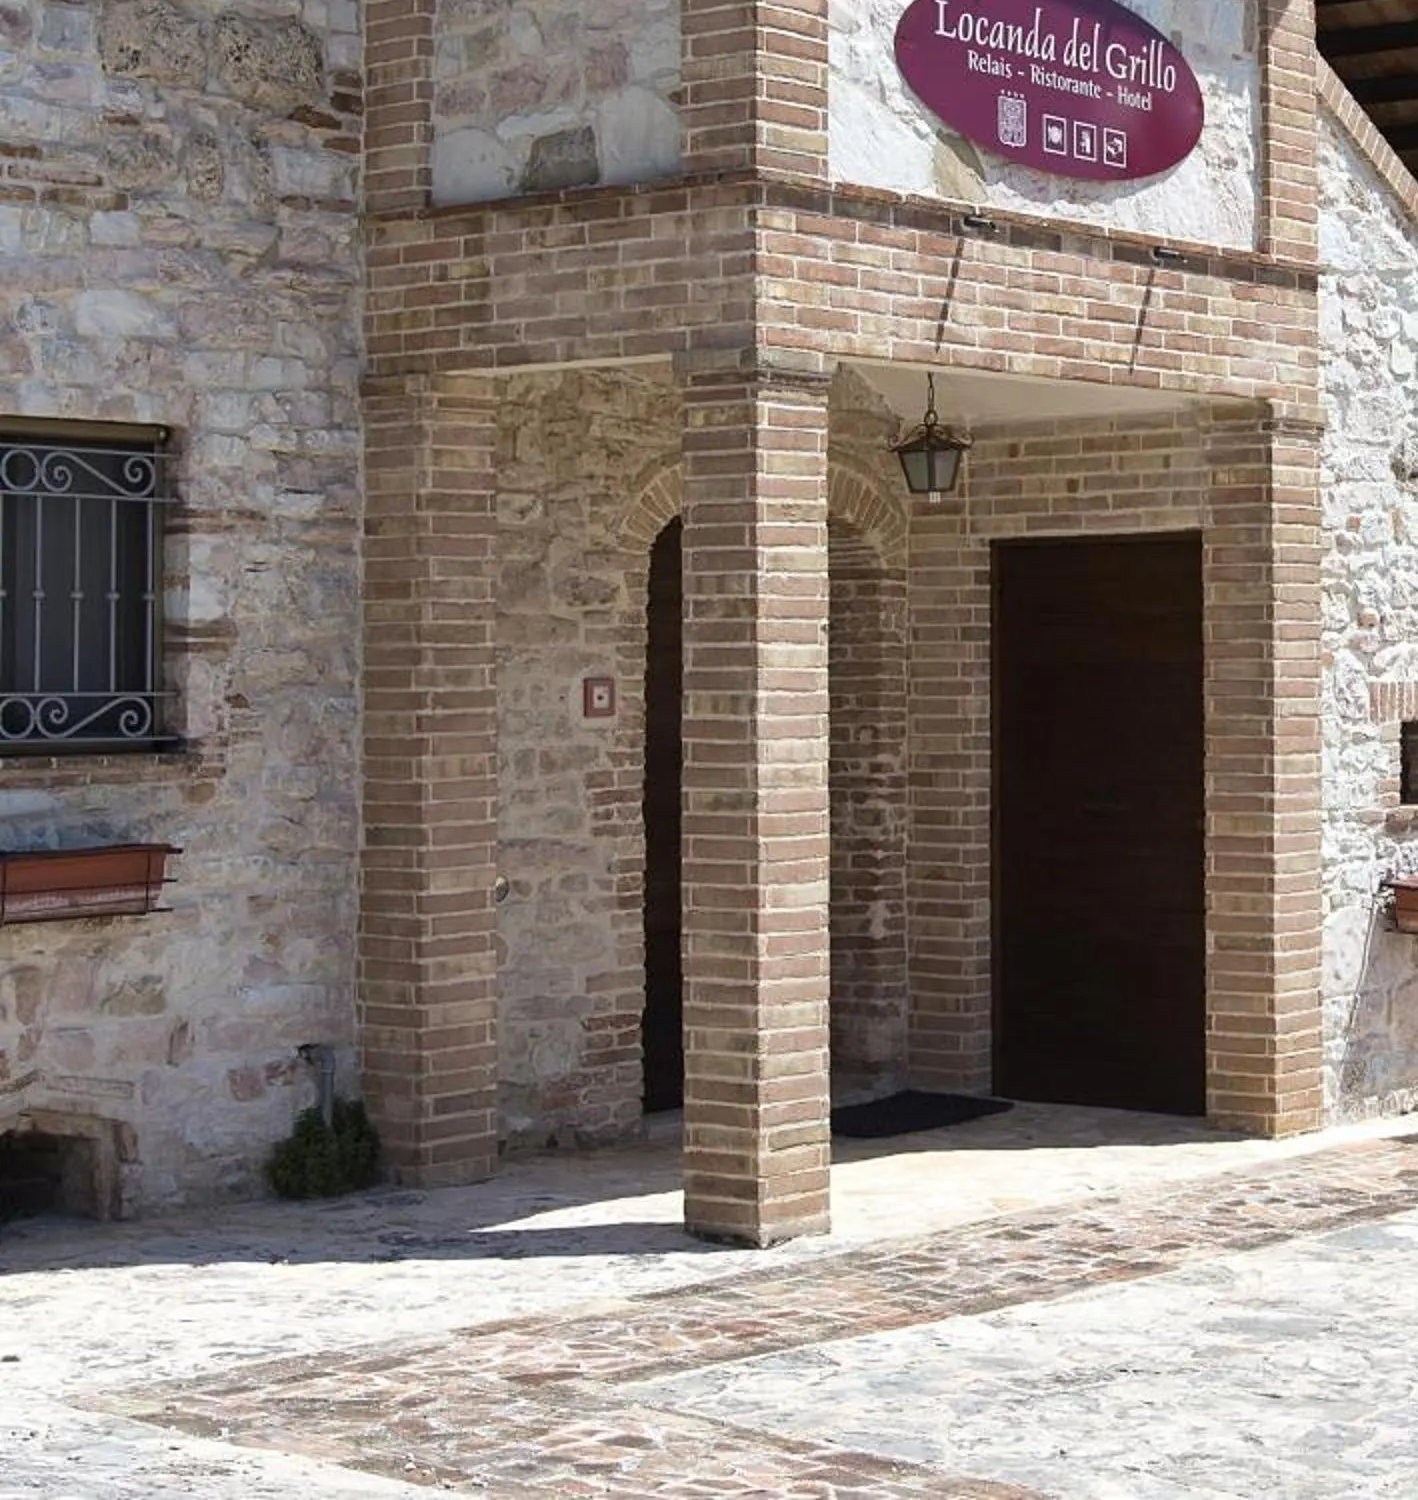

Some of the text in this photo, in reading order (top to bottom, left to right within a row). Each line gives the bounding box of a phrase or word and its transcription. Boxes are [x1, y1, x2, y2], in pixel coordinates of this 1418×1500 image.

[934, 0, 1177, 92] Locanda del Grillo
[967, 50, 1013, 79] Relais
[1030, 62, 1102, 99] Ristorante
[1117, 85, 1153, 111] Hotel
